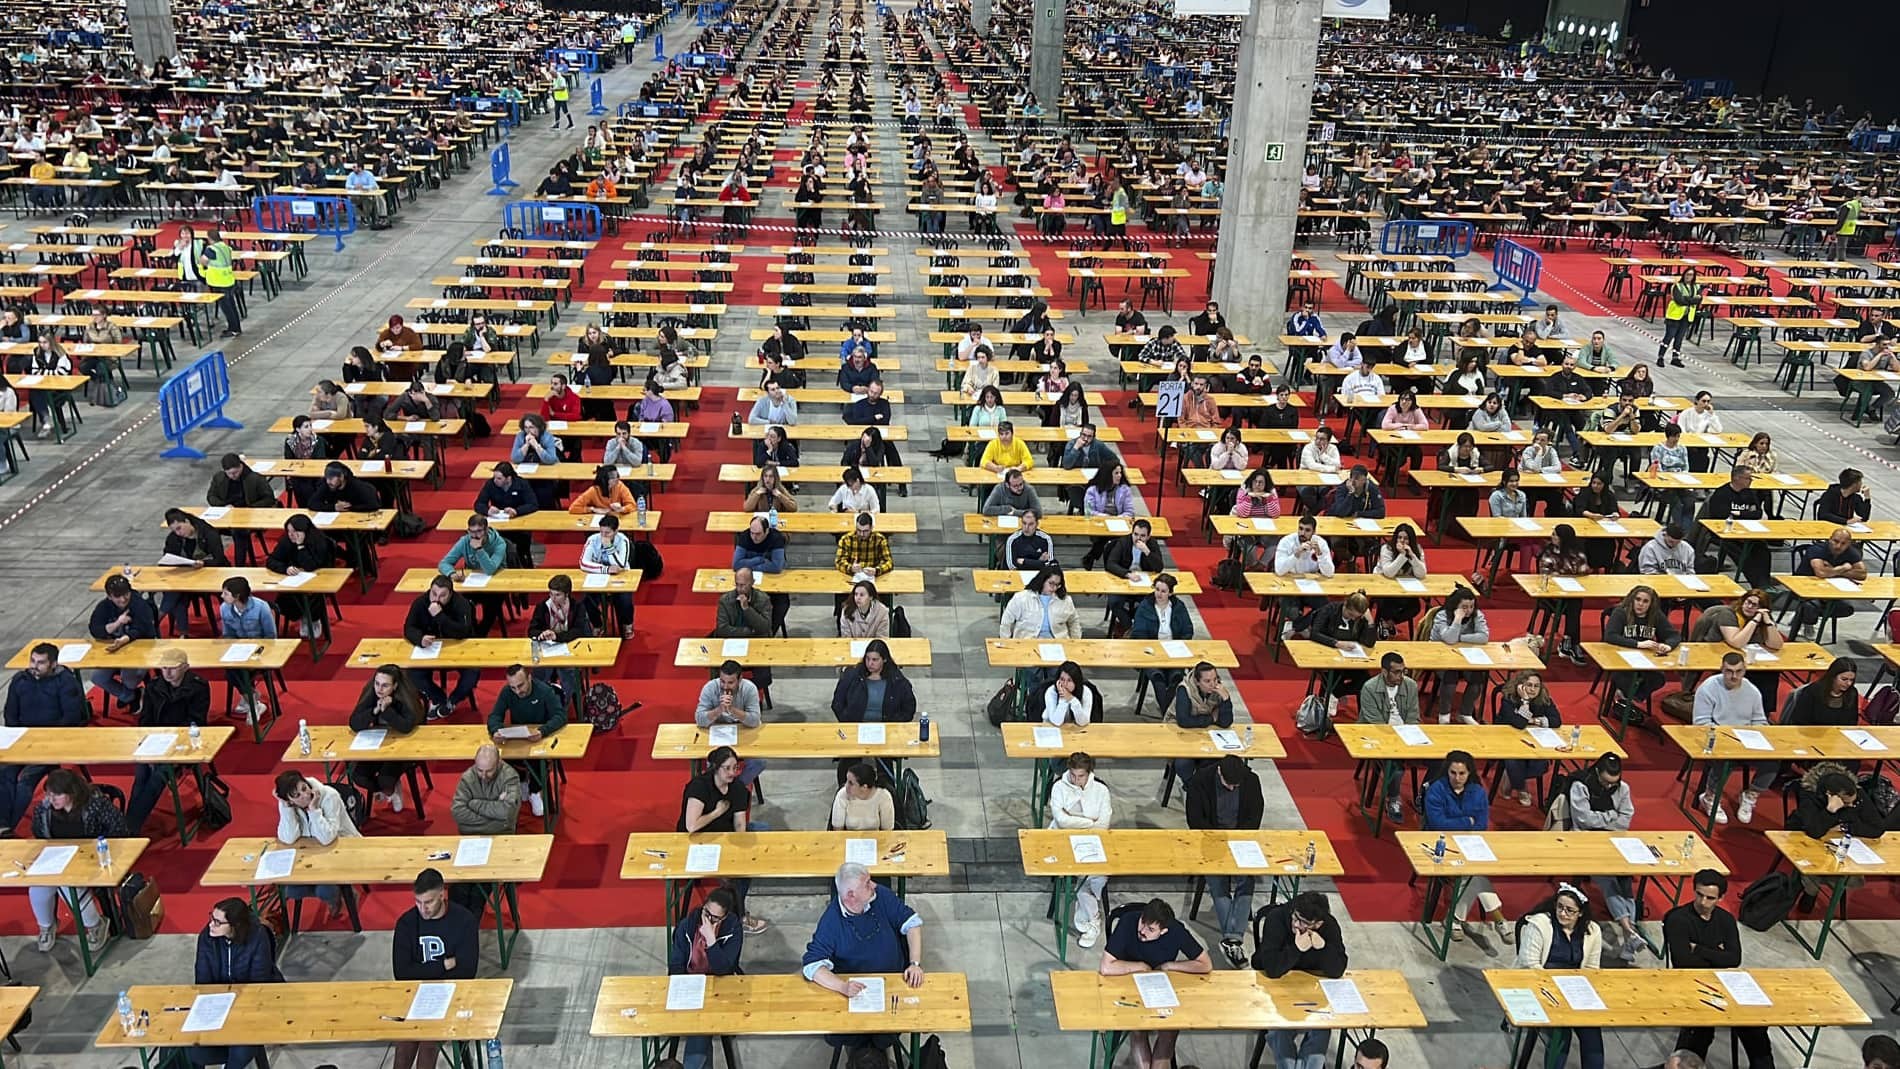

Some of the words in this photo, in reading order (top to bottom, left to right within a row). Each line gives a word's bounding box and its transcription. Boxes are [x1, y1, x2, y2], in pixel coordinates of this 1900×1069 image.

[1323, 127, 1334, 140] 19
[1160, 382, 1183, 391] PORTA
[1158, 393, 1181, 416] 21
[419, 935, 446, 964] P
